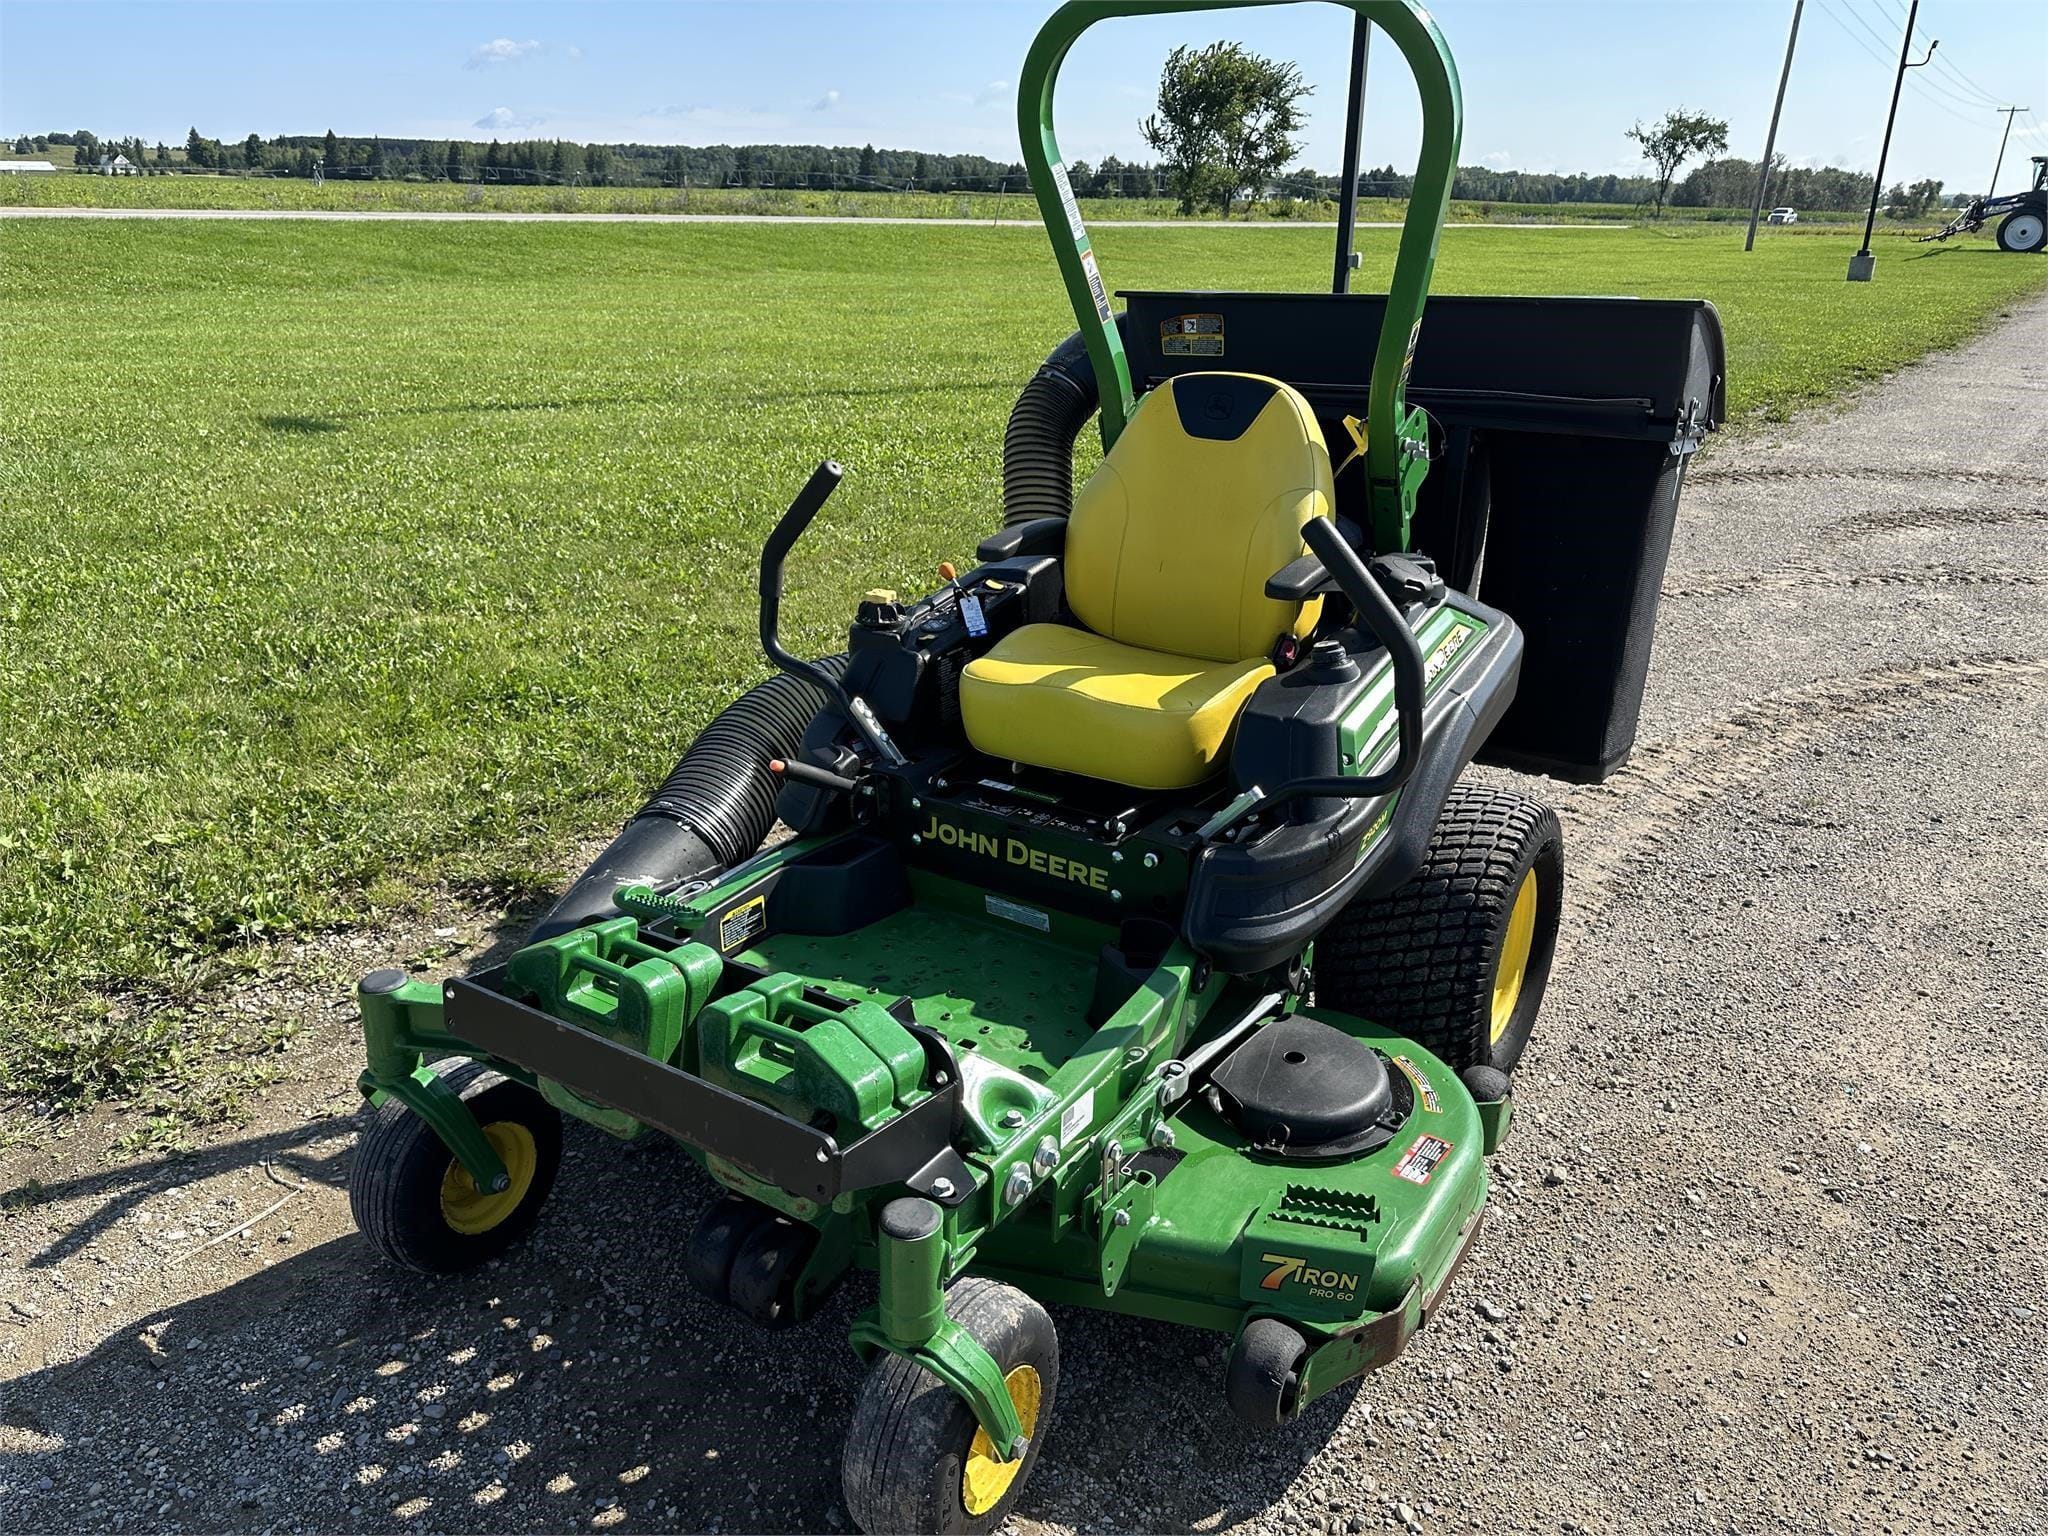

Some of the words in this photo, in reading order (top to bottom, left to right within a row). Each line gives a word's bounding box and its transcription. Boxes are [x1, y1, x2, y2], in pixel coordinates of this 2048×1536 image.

[922, 816, 999, 859] JOHN
[1006, 838, 1109, 891] DEERE
[1308, 1287, 1334, 1299] PRO
[1336, 1291, 1354, 1302] 60
